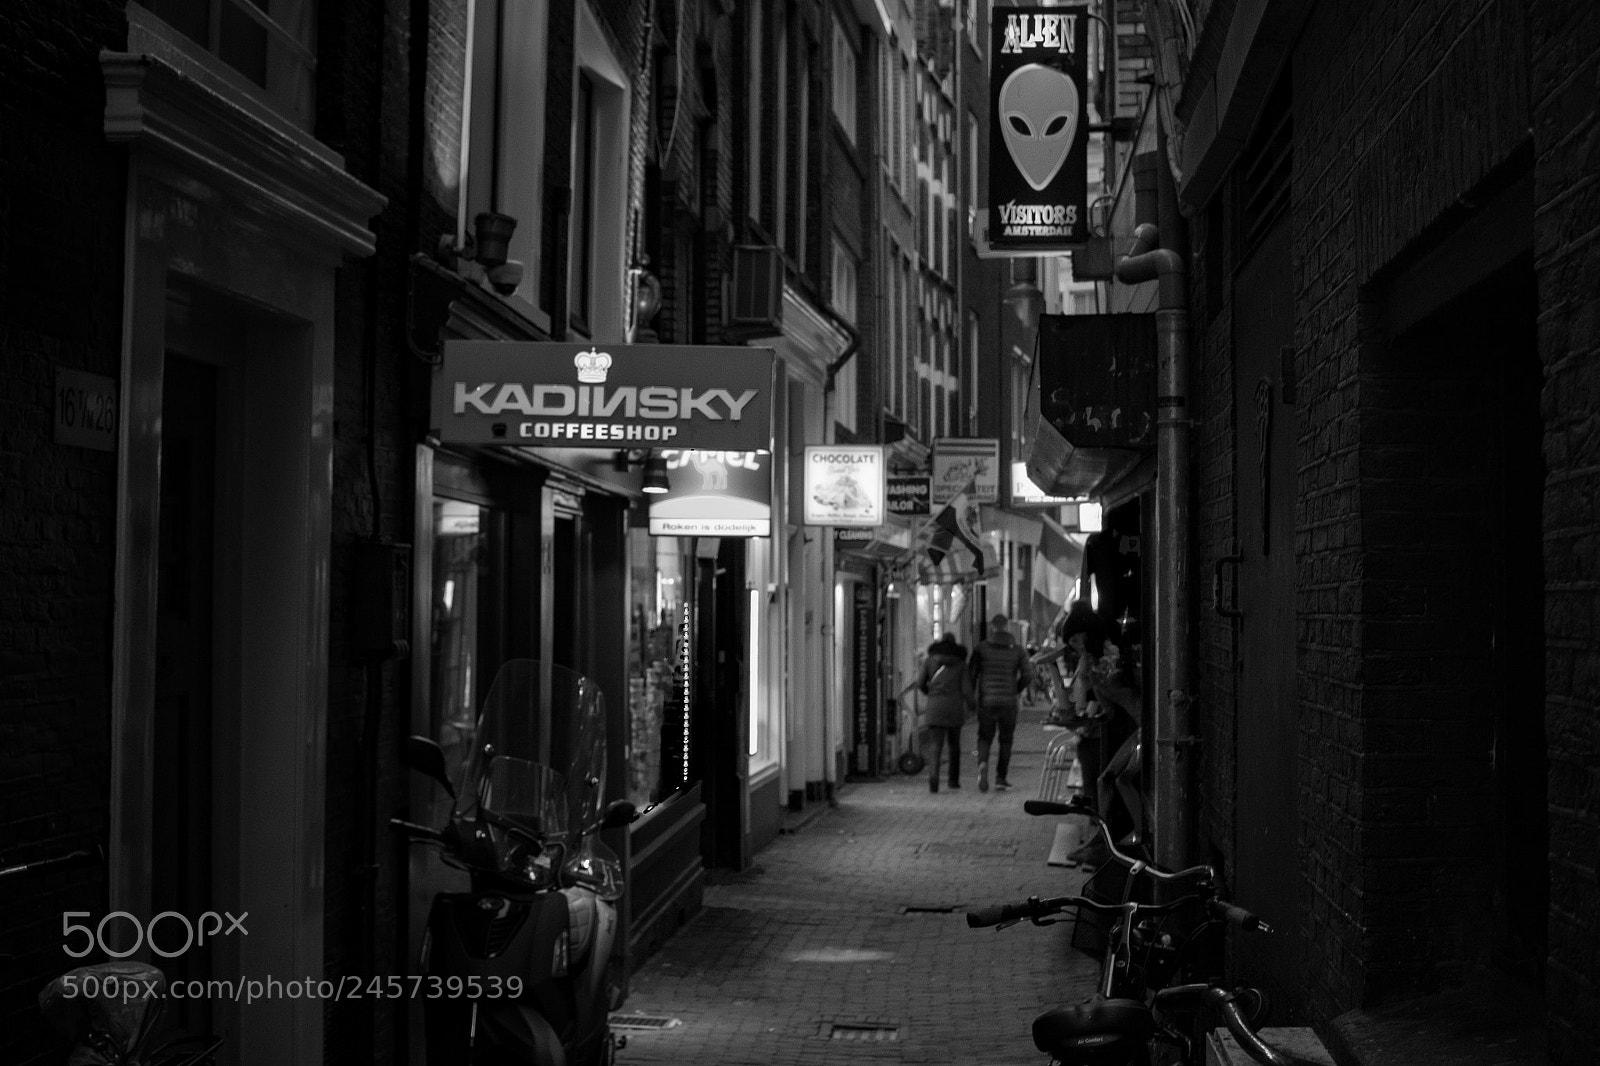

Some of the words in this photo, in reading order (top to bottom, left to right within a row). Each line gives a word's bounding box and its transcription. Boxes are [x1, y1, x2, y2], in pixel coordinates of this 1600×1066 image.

[1001, 14, 1078, 53] ALIEN
[998, 200, 1077, 225] VISITORS
[1002, 225, 1073, 237] AMSTERDAM
[59, 386, 75, 427] 16
[96, 394, 114, 433] 26
[519, 422, 678, 441] COFFEESHOP
[812, 453, 875, 464] CHOCOLATE
[662, 522, 698, 531] Roken
[701, 522, 710, 531] is
[714, 522, 757, 533] dodelijk
